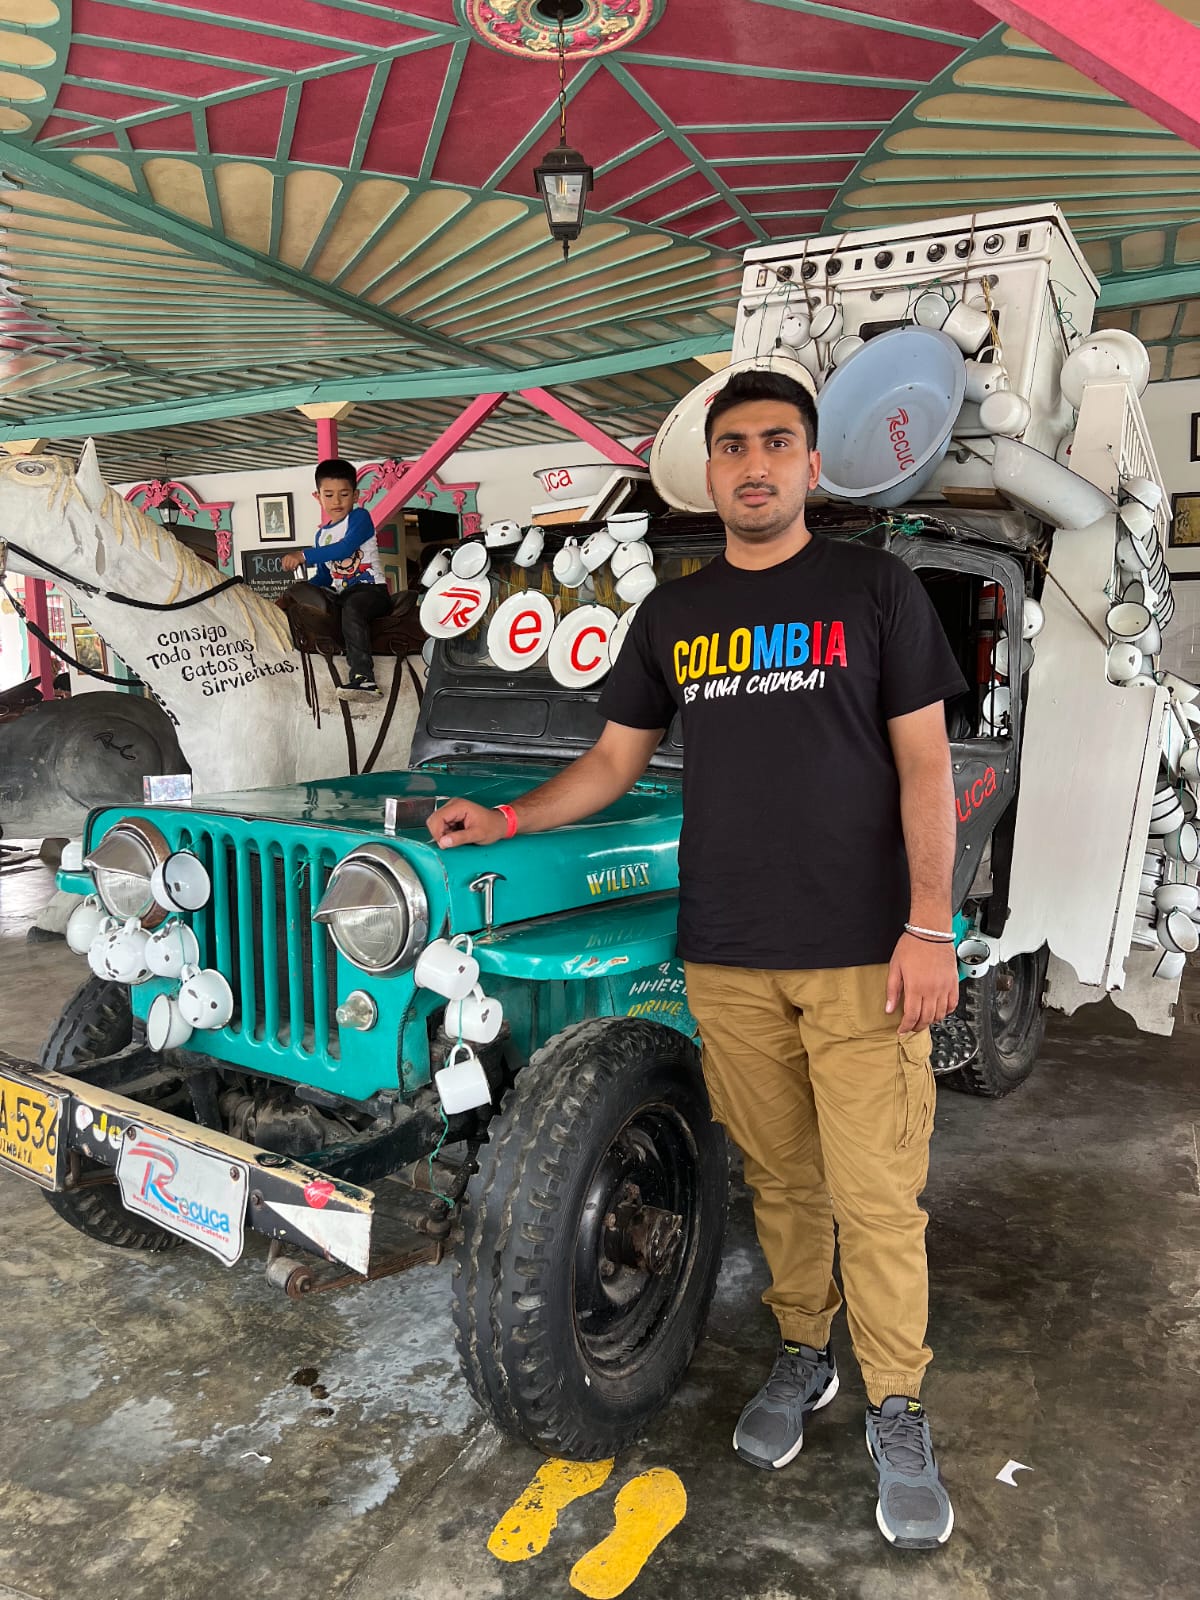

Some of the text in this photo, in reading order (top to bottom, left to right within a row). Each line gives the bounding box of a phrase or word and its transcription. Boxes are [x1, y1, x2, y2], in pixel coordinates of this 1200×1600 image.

[181, 657, 239, 682] Gatos
[674, 621, 848, 684] COLOMBIA
[683, 669, 826, 705] ES UNA CHIMBA!
[586, 862, 650, 897] WILLYS
[627, 1000, 685, 1018] DRIVE
[128, 1141, 230, 1234] Recuca
